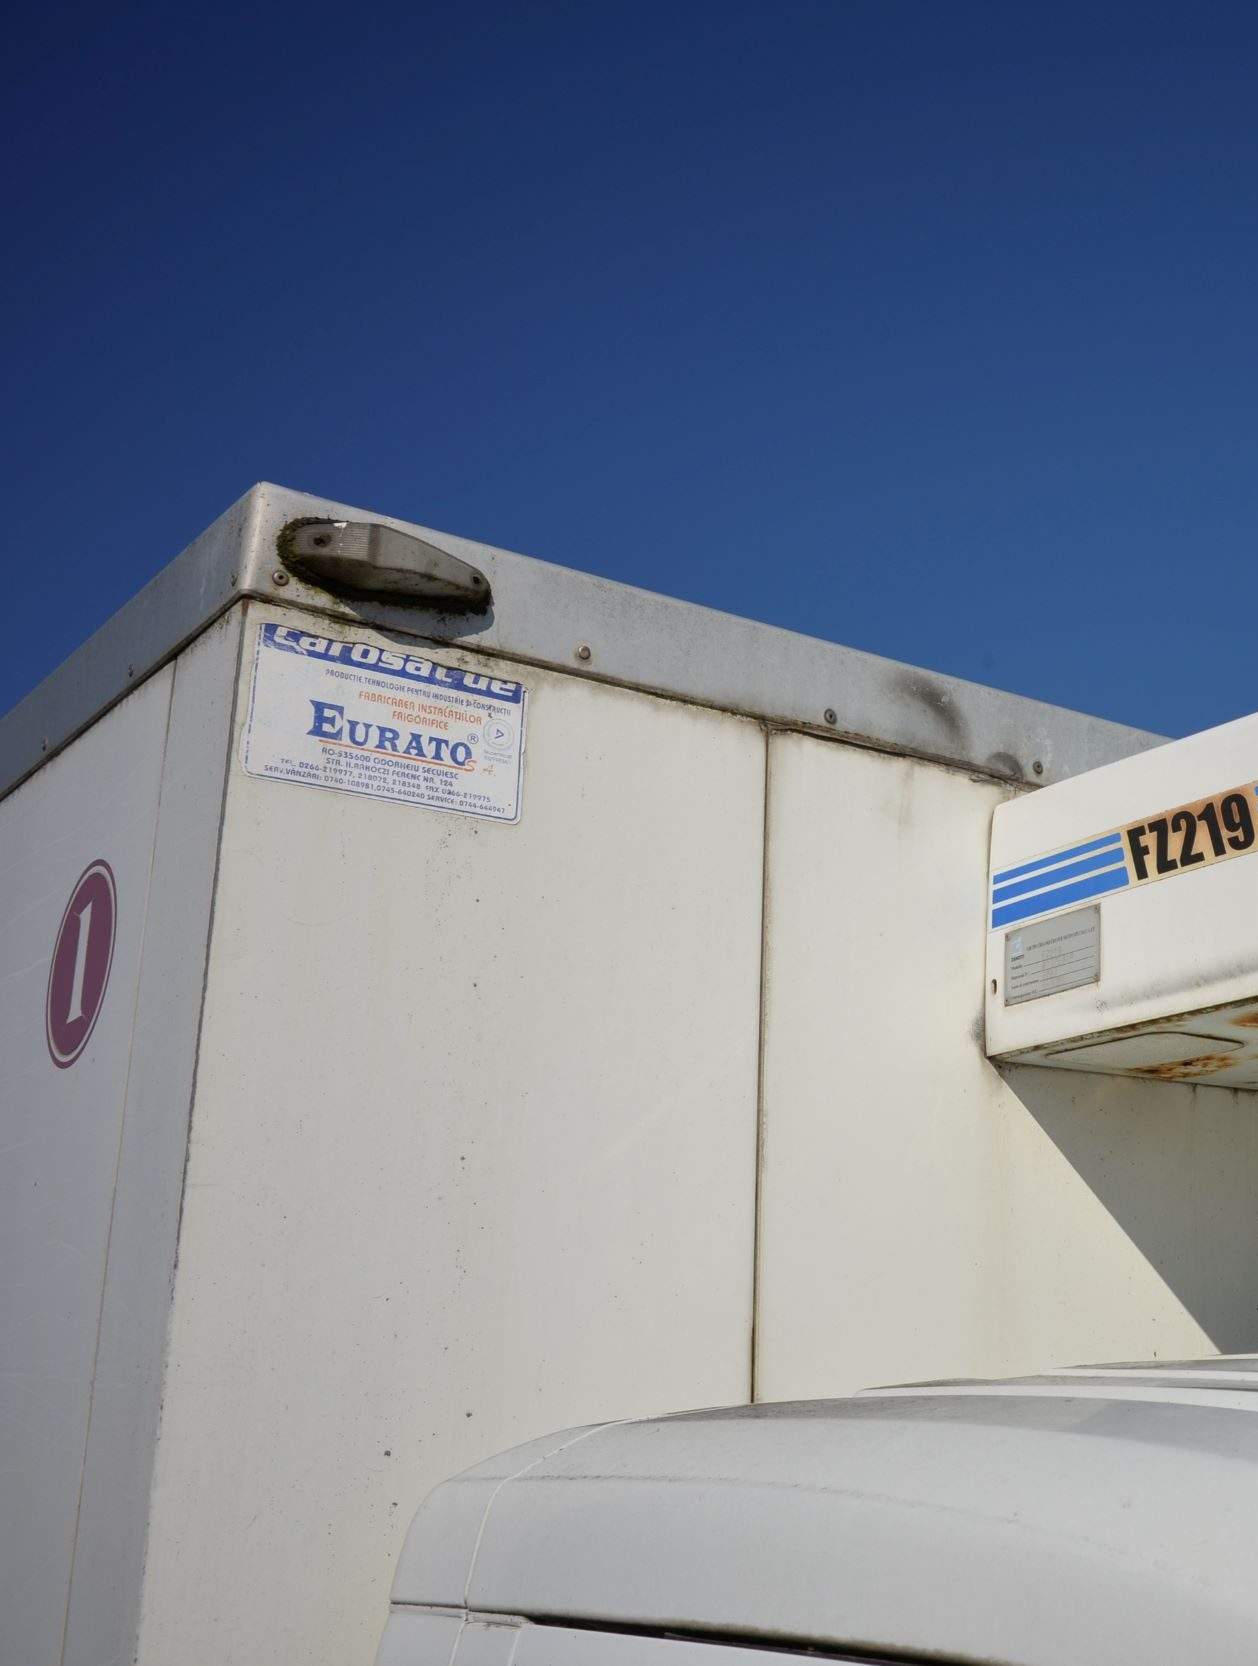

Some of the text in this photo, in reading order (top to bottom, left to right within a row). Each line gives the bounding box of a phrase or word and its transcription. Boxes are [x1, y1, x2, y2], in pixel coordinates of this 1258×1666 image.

[391, 710, 449, 731] FRIGORIFICE
[373, 756, 419, 772] ODORHEIU
[421, 766, 458, 780] SECUIESC
[1127, 793, 1256, 881] FZ219
